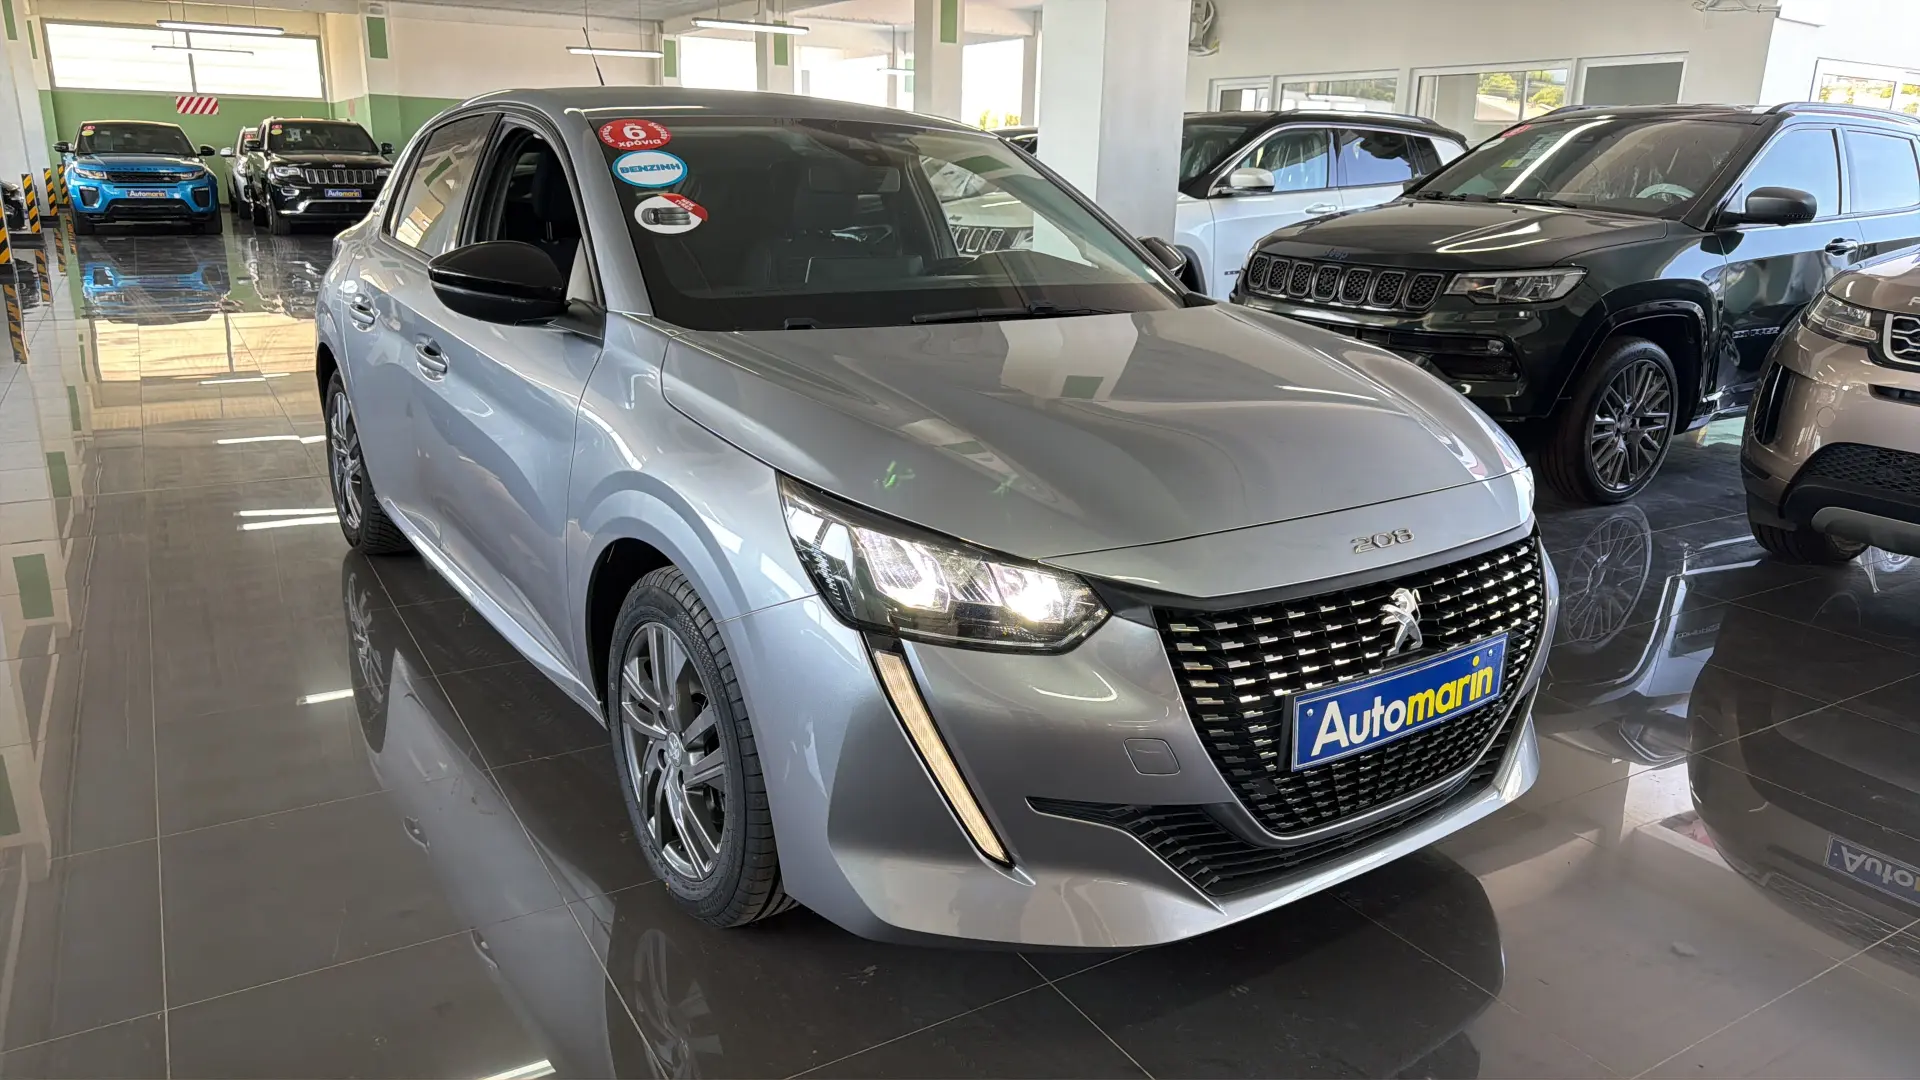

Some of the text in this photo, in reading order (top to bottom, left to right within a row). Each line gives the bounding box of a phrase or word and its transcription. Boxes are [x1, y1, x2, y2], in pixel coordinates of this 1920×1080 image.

[623, 125, 647, 140] 6
[618, 139, 662, 147] χρόνια
[129, 190, 166, 198] Automarin
[327, 189, 360, 197] Automarin
[1324, 247, 1349, 260] Jeep
[1350, 528, 1415, 555] 208
[1310, 656, 1493, 758] Automarin
